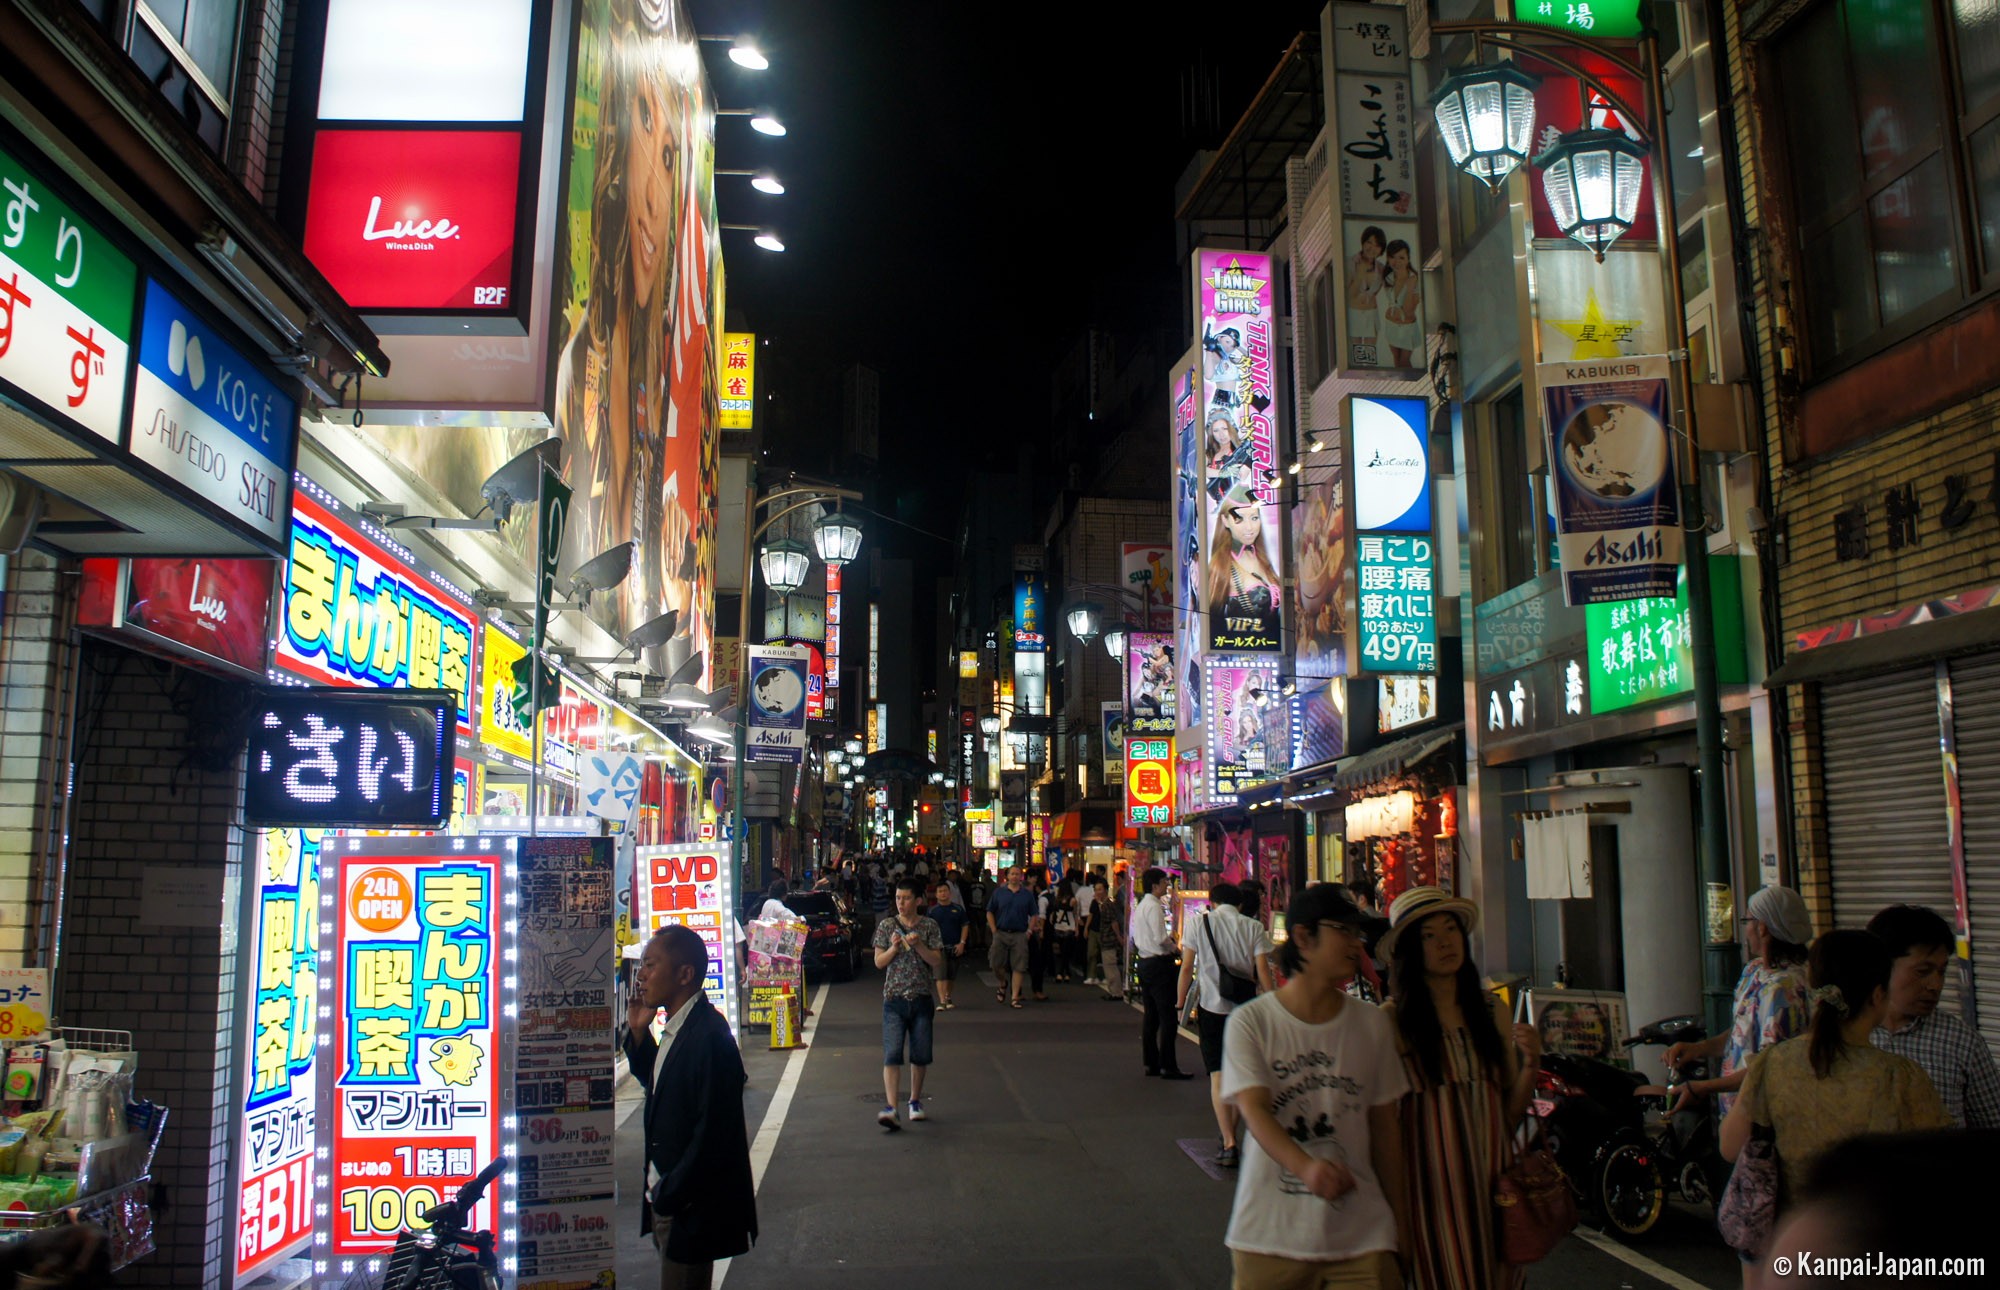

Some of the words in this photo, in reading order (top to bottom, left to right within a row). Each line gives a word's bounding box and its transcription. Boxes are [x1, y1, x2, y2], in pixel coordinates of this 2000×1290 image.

[1372, 42, 1402, 57] ビル
[385, 242, 435, 251] Wine&Dish
[1211, 267, 1255, 291] TANK
[473, 286, 507, 306] B2F
[1214, 291, 1261, 315] GIRLS
[725, 338, 751, 350] リーチ
[1247, 321, 1271, 399] TANK
[727, 351, 748, 396] 麻雀
[215, 364, 273, 448] KOSÉ
[145, 407, 226, 482] SHISEIDO
[1359, 536, 1431, 563] 肩こり
[1584, 528, 1663, 567] Asahi
[1360, 565, 1432, 591] 腰痛
[286, 536, 472, 708] まんが喫茶
[1363, 620, 1425, 634] 10分あたり
[1214, 635, 1278, 648] ガールズバー
[1363, 634, 1435, 662] 497円
[1417, 662, 1435, 672] から
[756, 729, 793, 746] Asahi
[1130, 741, 1169, 760] 2階
[1137, 769, 1164, 797] 風
[1131, 806, 1170, 823] 受付
[650, 856, 718, 884] DVD
[364, 877, 399, 896] 24h
[358, 898, 403, 921] OPEN
[423, 872, 483, 1031] まんが
[254, 898, 294, 1093] 喫茶
[355, 947, 414, 1078] 喫茶
[347, 1089, 487, 1131] マンボー
[341, 1161, 391, 1177] はじめの
[394, 1144, 474, 1178] 1時間
